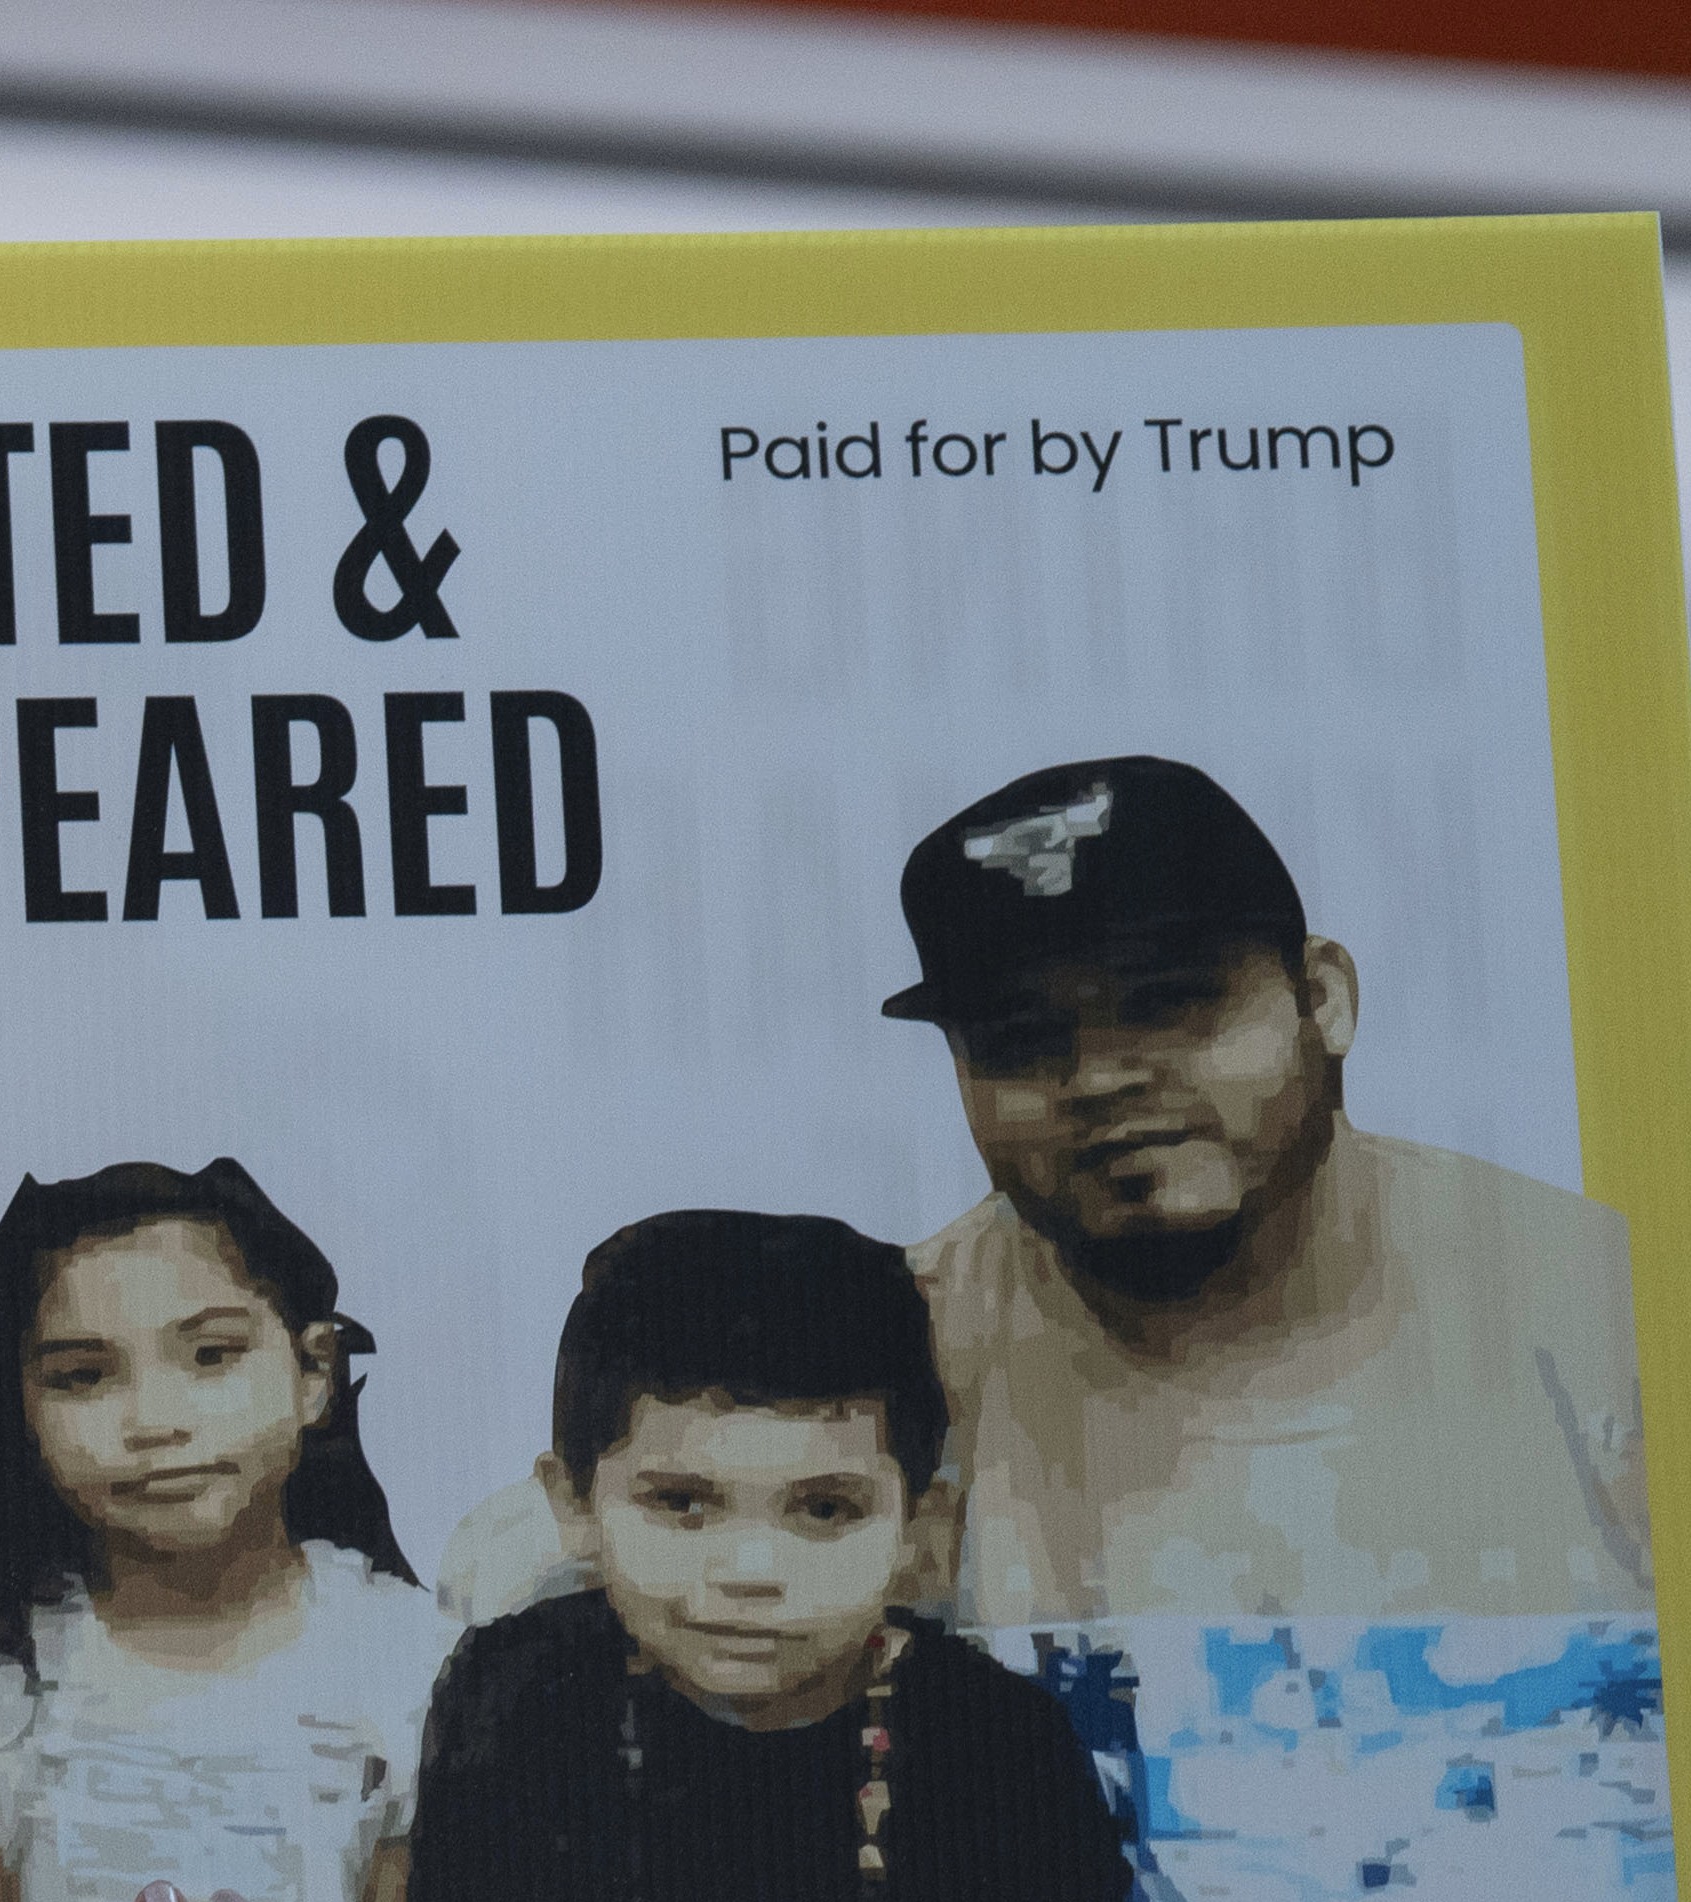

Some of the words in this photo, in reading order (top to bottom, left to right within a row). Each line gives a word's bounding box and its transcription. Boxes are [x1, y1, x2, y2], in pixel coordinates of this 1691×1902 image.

[331, 413, 462, 644] &
[719, 420, 883, 482] Paid
[904, 418, 1008, 479] for
[1029, 417, 1123, 494] by
[1143, 416, 1396, 489] Trump
